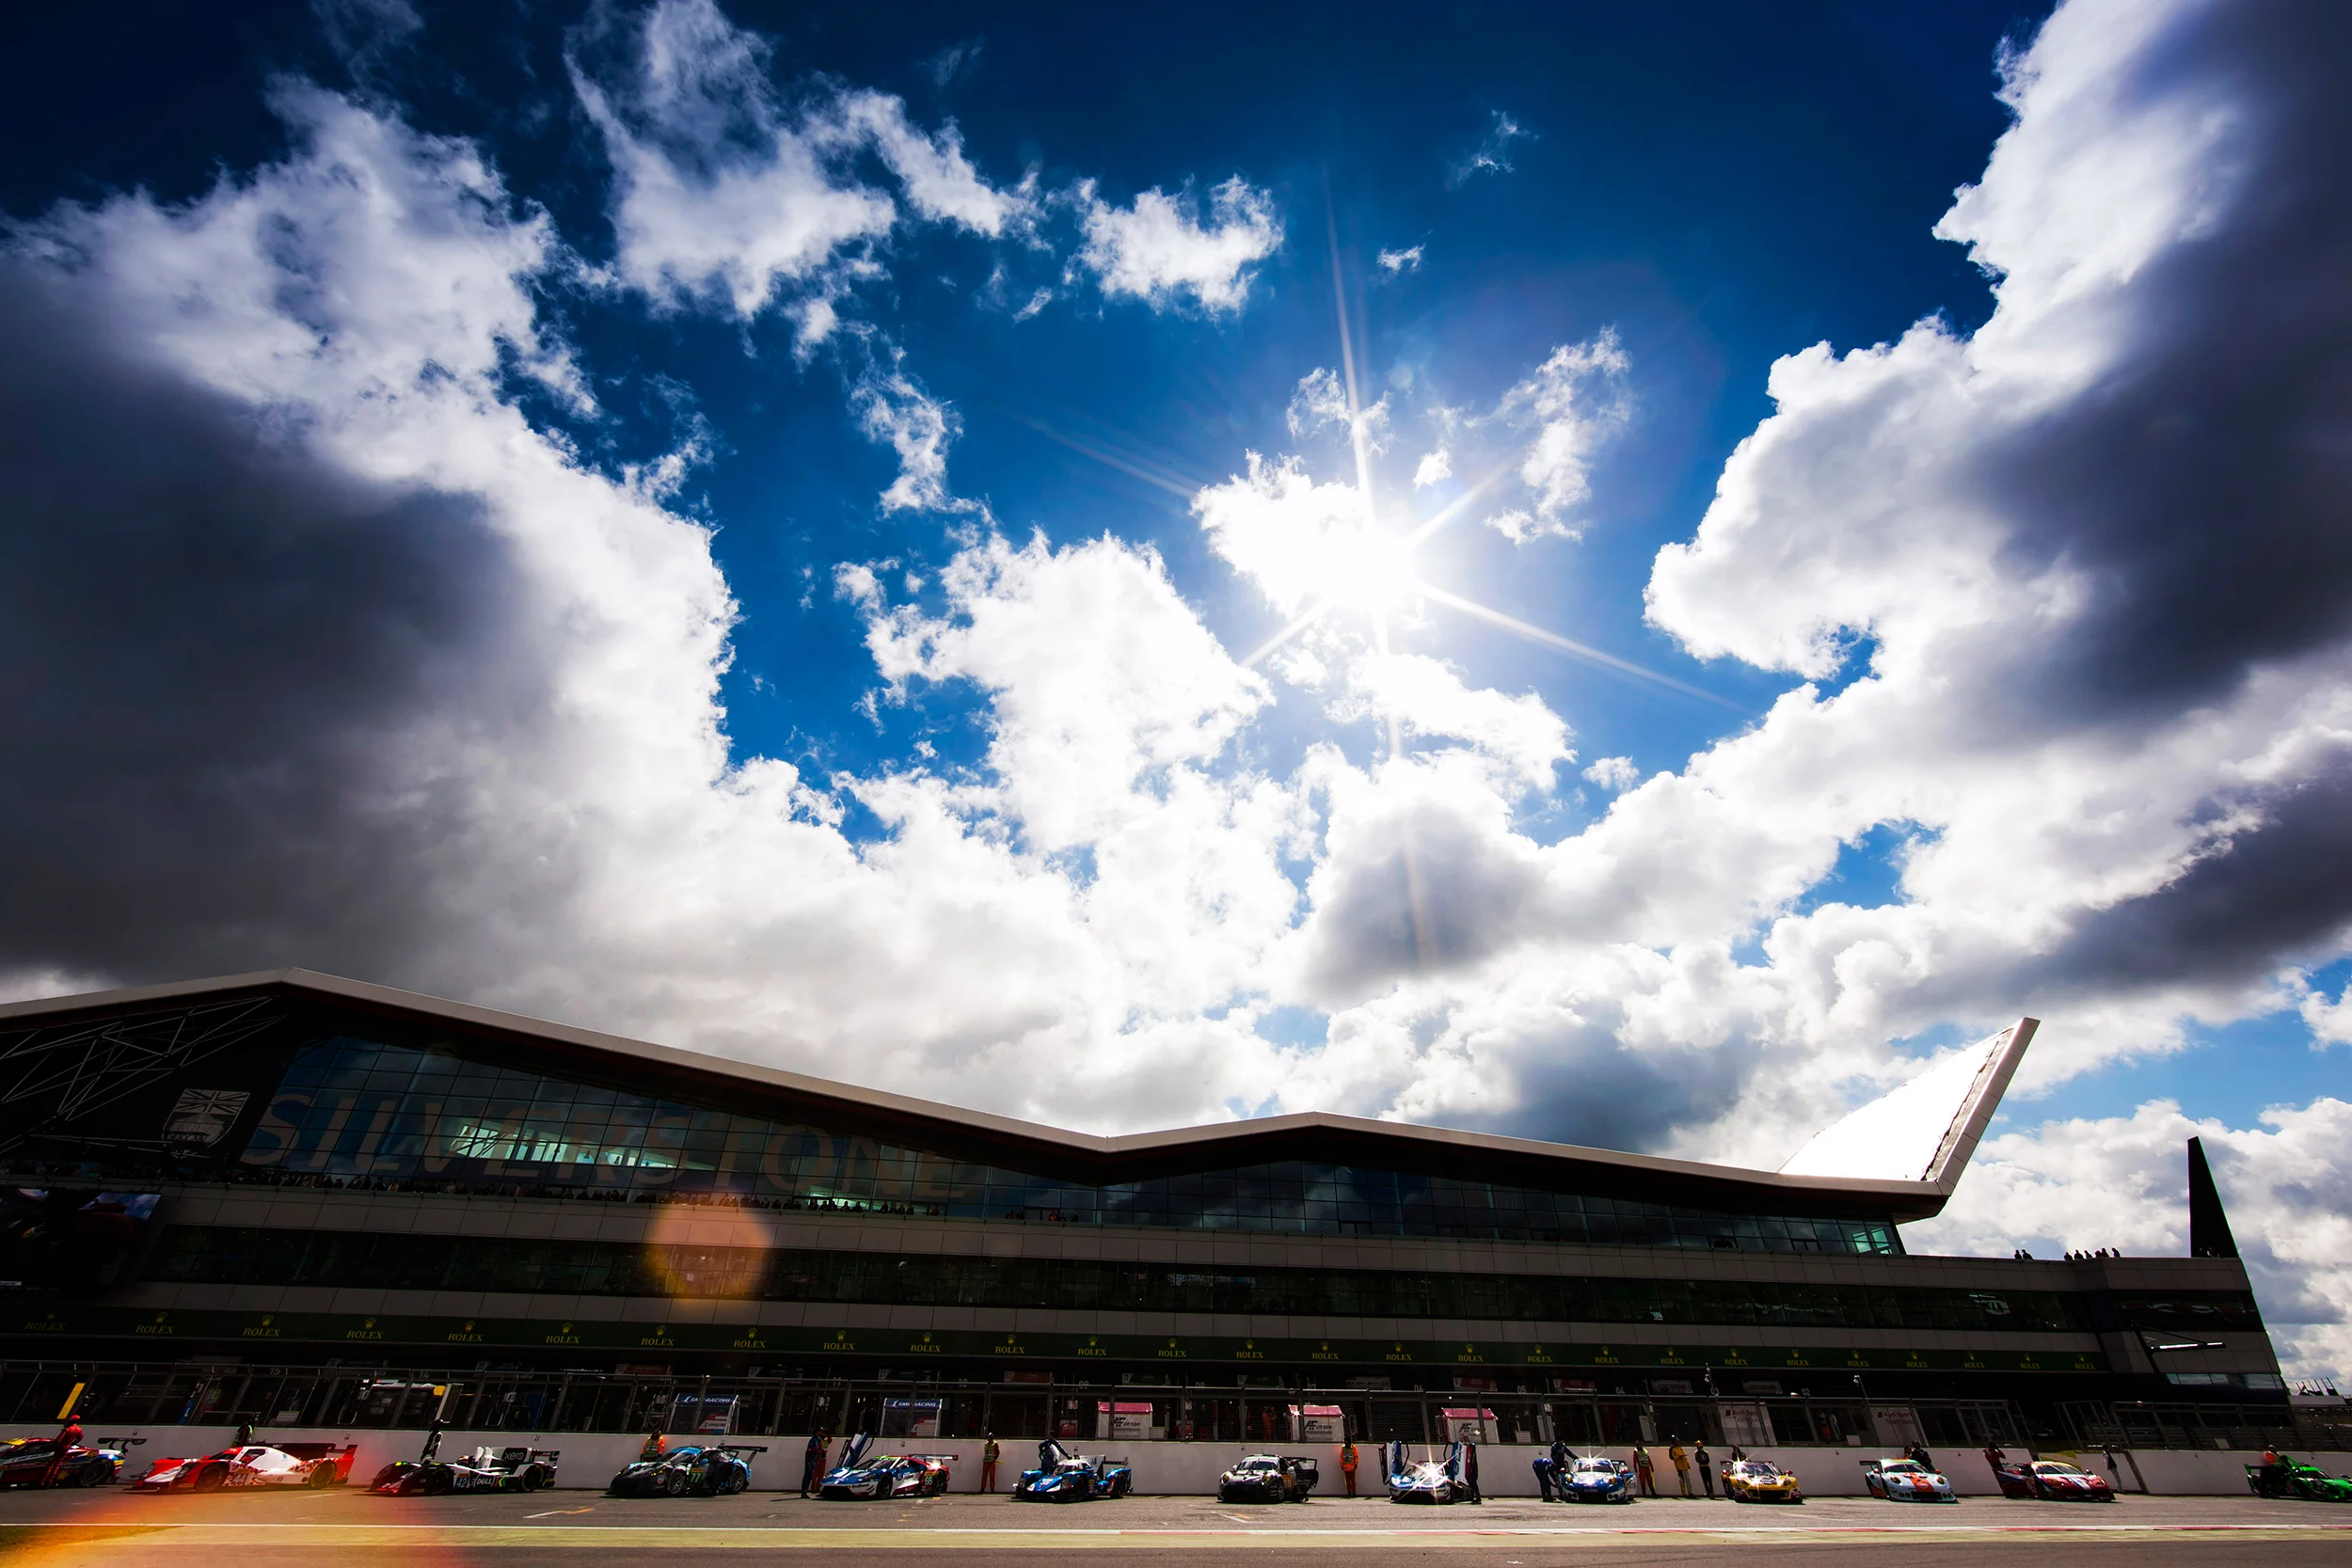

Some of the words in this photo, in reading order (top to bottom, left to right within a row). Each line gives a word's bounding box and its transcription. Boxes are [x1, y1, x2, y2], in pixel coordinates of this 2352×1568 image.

[239, 1093, 965, 1198] SILVERSTONE
[25, 1322, 66, 1332] ROLEX
[135, 1325, 174, 1335] ROLEX
[243, 1327, 279, 1337] ROLEX
[448, 1334, 483, 1342] ROLEX
[546, 1336, 580, 1344] ROLEX
[1517, 1386, 1526, 1394] 05
[1614, 1386, 1625, 1395] 04
[503, 1452, 524, 1461] xero
[690, 1473, 700, 1483] 77
[924, 1477, 932, 1485] 66
[456, 1478, 467, 1488] 42
